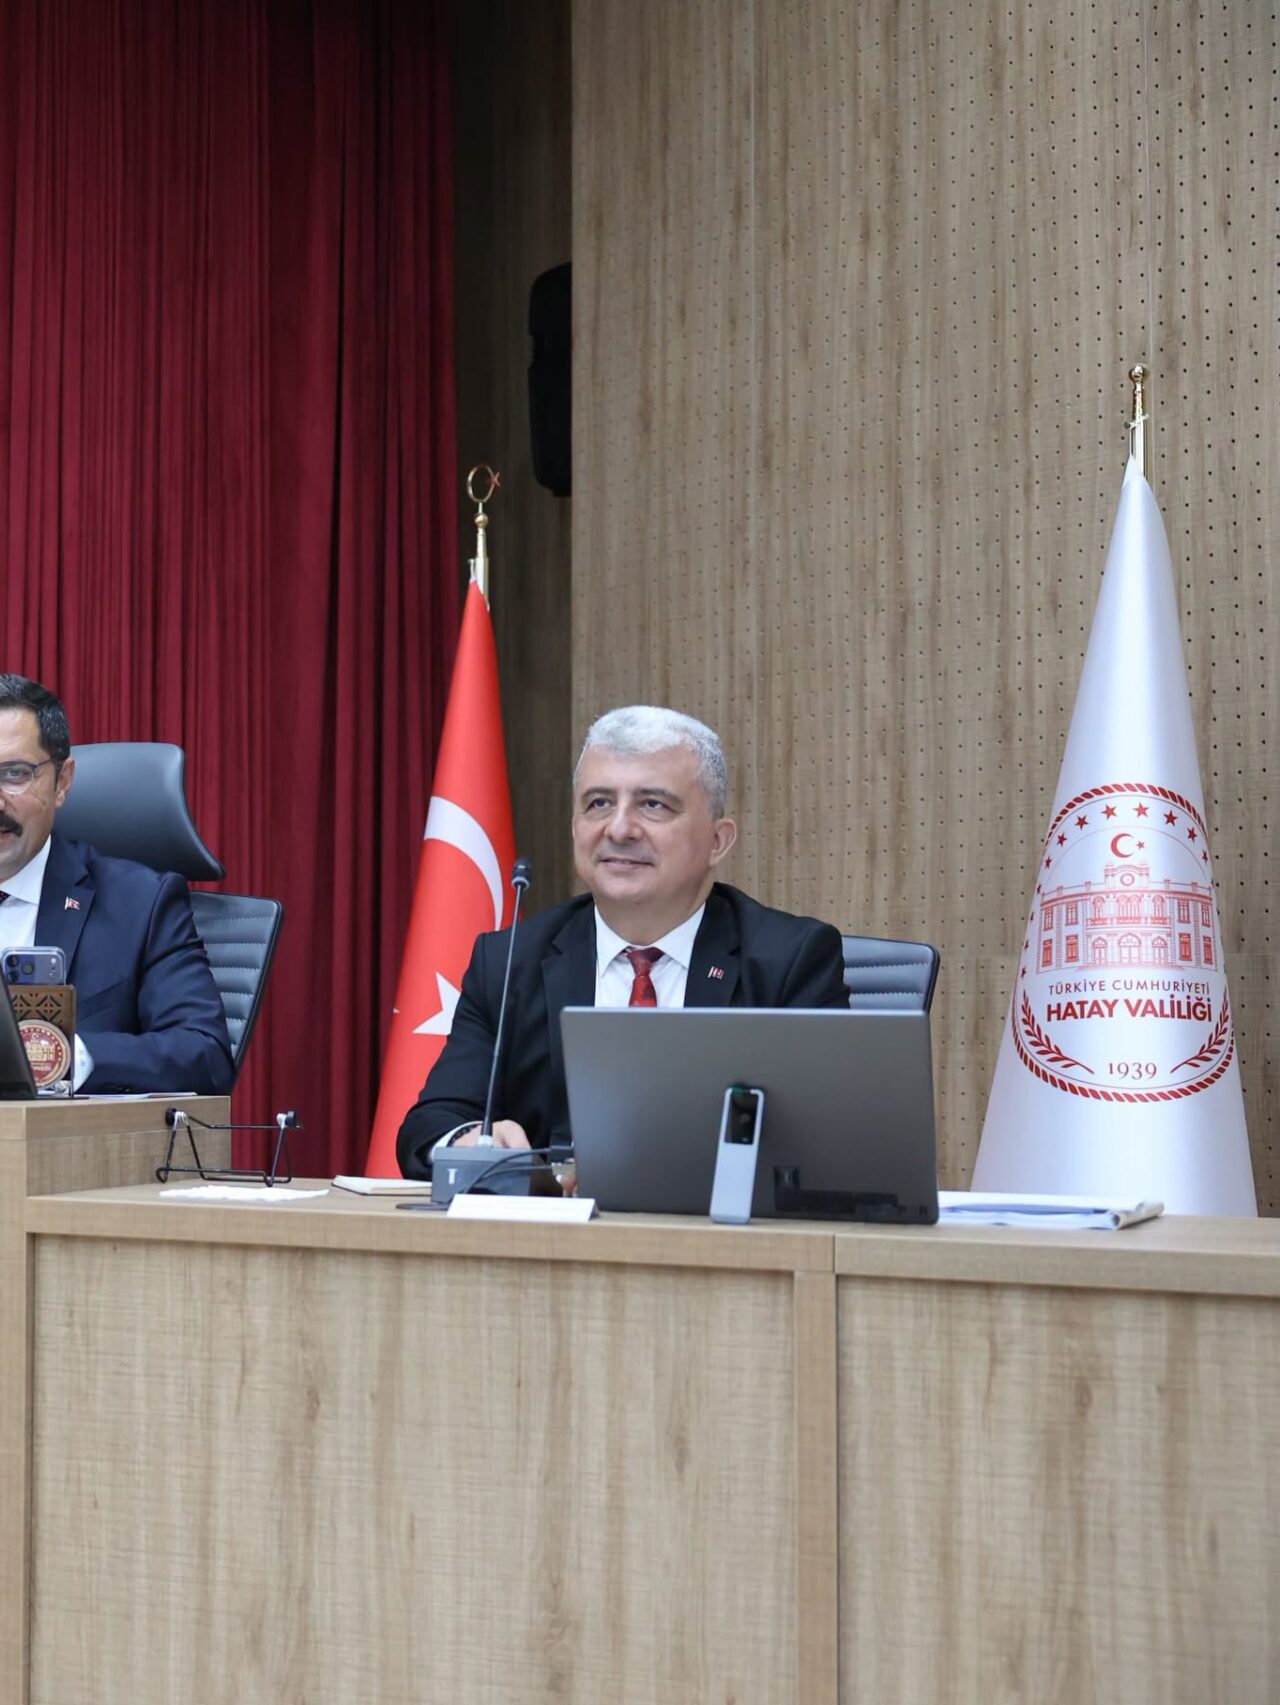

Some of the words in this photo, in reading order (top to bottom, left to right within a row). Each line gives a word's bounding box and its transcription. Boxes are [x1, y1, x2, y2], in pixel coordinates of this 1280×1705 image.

[1048, 979, 1106, 996] TÜRKİYE
[1112, 978, 1210, 995] CUMHURİYETİ
[1046, 998, 1118, 1022] HATAY
[1123, 993, 1213, 1022] VALİLİĞİ
[1108, 1062, 1158, 1081] 1939
